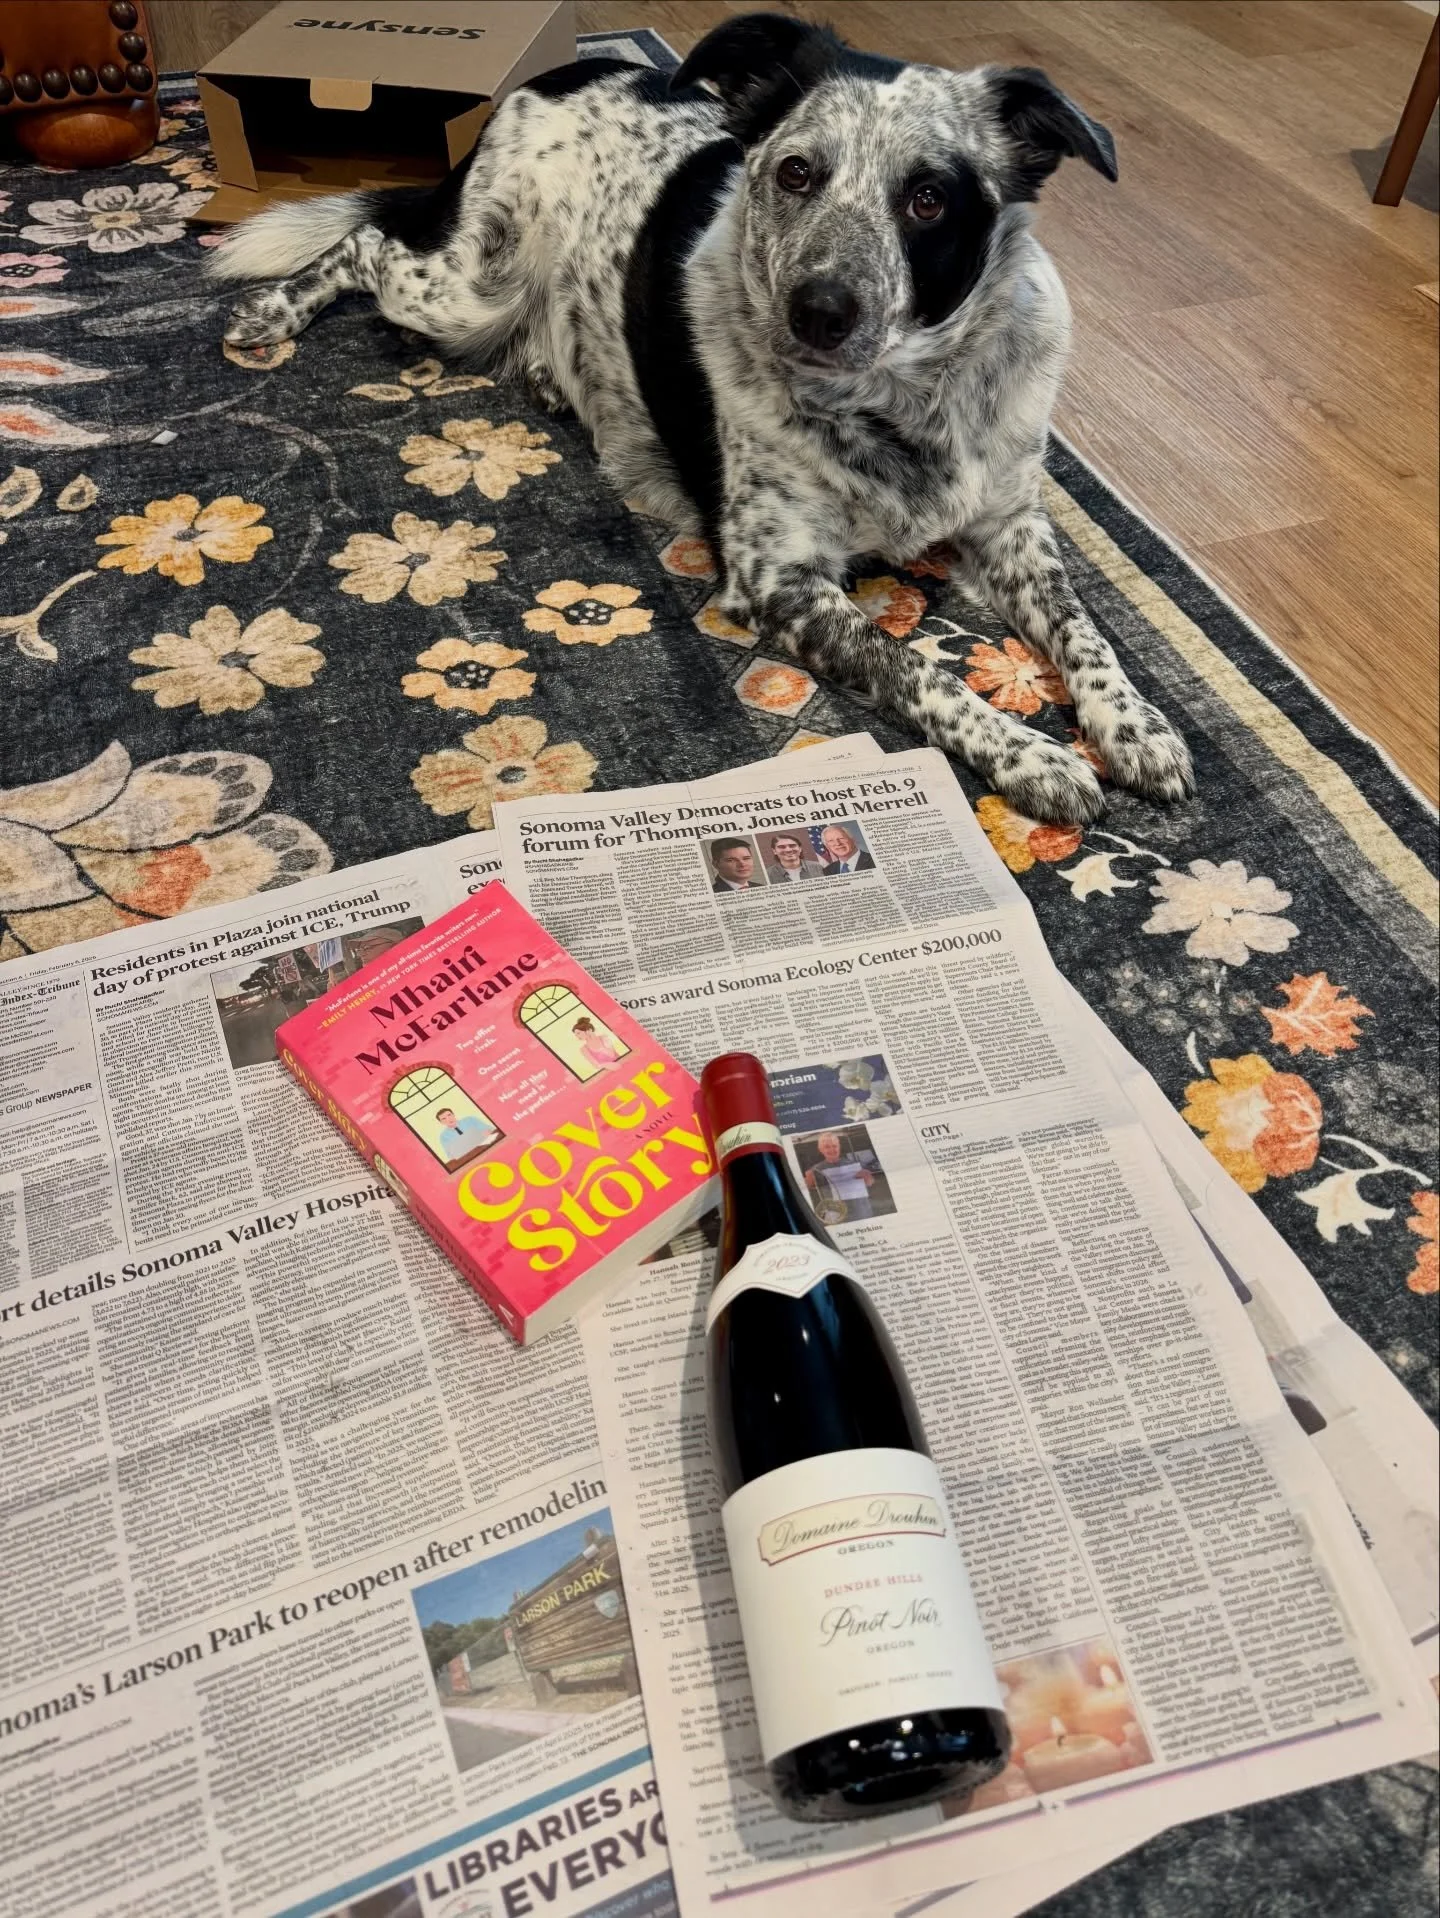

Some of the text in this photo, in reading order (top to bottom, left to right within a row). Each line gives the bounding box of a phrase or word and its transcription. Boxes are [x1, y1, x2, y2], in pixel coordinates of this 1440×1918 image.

[293, 18, 486, 40] Sensyne
[519, 778, 916, 836] Sonoma Valley Democrats to host Feb. 9
[522, 791, 929, 854] forum for Thompson, Jones and Merrell
[91, 890, 380, 981] Residents in Plaza join national
[93, 901, 411, 997] day of protest against ICE, Trump
[349, 989, 380, 1010] HENRY,
[387, 974, 401, 985] NEW
[401, 962, 418, 975] YORK
[420, 951, 436, 964] TIMES
[437, 925, 476, 953] BESTSELLING
[476, 908, 502, 927] AUTHOR
[368, 977, 379, 986] one
[380, 969, 388, 978] of
[388, 964, 398, 973] my
[398, 948, 422, 966] all-time
[420, 934, 445, 953] favorite
[444, 923, 462, 937] writers
[616, 929, 1002, 1010] sors award Sonoma Ecology Center $200,000
[0, 988, 22, 996] ALLEY
[23, 982, 45, 991] SINCE
[0, 979, 81, 1006] Index-Tribune
[368, 945, 487, 1029] Mhairi
[355, 953, 539, 1075] McFarlane
[456, 1024, 496, 1051] Two office
[478, 1047, 521, 1075] One secret
[109, 1084, 150, 1099] Minneapolis.
[160, 1081, 181, 1092] fatally
[204, 1069, 227, 1079] during
[498, 1069, 548, 1103] Now all they
[769, 1072, 817, 1089] moriam
[5, 1082, 92, 1115] Group NEWSPAPER
[283, 1048, 367, 1151] Cover Story
[518, 1088, 538, 1104] need
[512, 1110, 529, 1121] the
[646, 1111, 674, 1132] NOVEL
[920, 1123, 951, 1138] CITY
[457, 1061, 673, 1223] Cover
[1024, 1145, 1048, 1154] change
[1051, 1140, 1070, 1149] global
[1083, 1160, 1118, 1172] continued,
[507, 1113, 713, 1271] Story
[260, 1237, 292, 1252] addition,
[294, 1230, 305, 1239] for
[306, 1226, 318, 1236] the
[320, 1221, 335, 1231] first
[337, 1216, 349, 1225] full
[351, 1212, 368, 1221] year,
[369, 1209, 381, 1217] the
[856, 1224, 883, 1235] Perkins
[31, 1271, 116, 1312] details
[121, 1239, 223, 1283] Sonoma
[226, 1210, 300, 1244] Valley
[303, 1184, 397, 1220] Hospita
[108, 1293, 128, 1304] more
[128, 1287, 145, 1298] than
[146, 1278, 177, 1295] doubling
[177, 1272, 194, 1283] from
[211, 1262, 219, 1270] to
[220, 1256, 236, 1267] 2025
[649, 1264, 679, 1276] Hannah
[1098, 1290, 1135, 1302] Nonprofits
[1140, 1284, 1155, 1293] such
[622, 1387, 649, 1399] Hannah
[1040, 1408, 1065, 1419] Mayor
[1069, 1404, 1084, 1412] Ron
[769, 1499, 939, 1556] Domaine Drouhin
[837, 1539, 896, 1556] OREGON
[514, 1562, 612, 1628] LARSON PARK
[823, 1573, 924, 1599] DUNDEE HILLS
[0, 1479, 609, 1739] noma’s Larson Park to reopen after remodelin
[819, 1597, 943, 1647] Pinot Noir
[866, 1639, 916, 1655] OREGON
[572, 1747, 588, 1758] THE
[589, 1734, 622, 1752] SONOMA
[424, 1787, 623, 1901] LIBRARIES
[628, 1779, 661, 1809] AR
[500, 1810, 669, 1918] EVERYO
